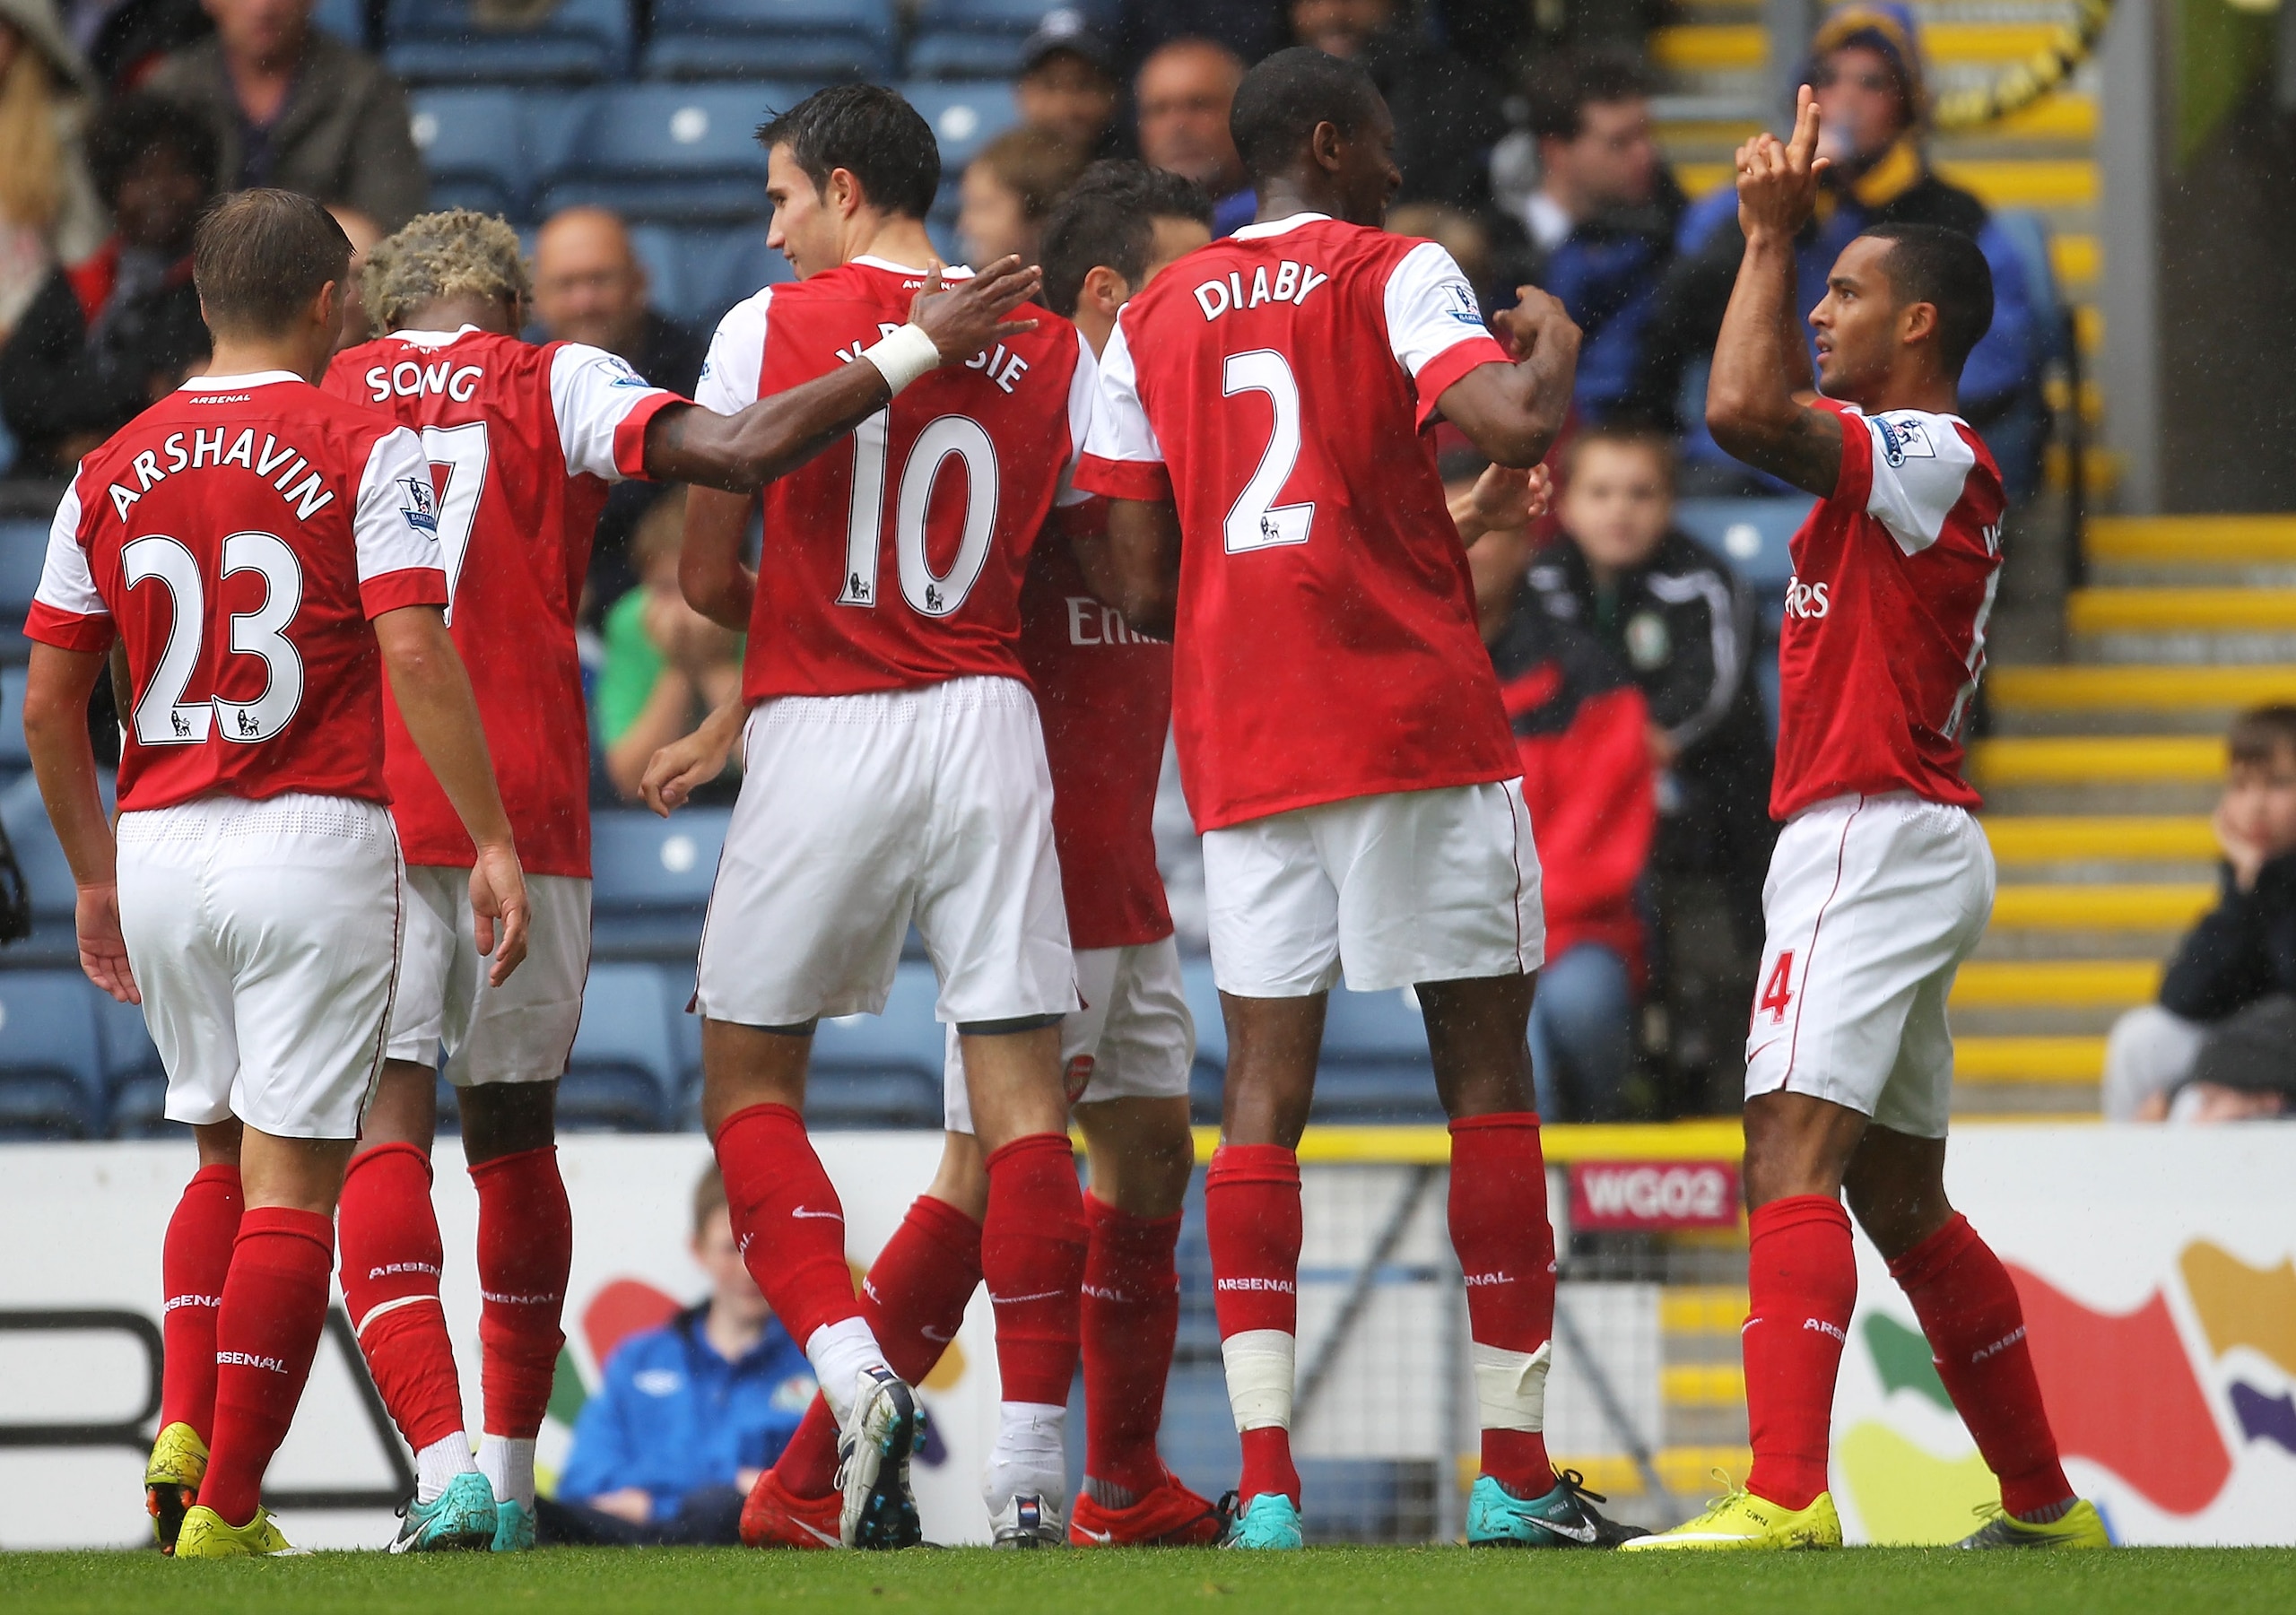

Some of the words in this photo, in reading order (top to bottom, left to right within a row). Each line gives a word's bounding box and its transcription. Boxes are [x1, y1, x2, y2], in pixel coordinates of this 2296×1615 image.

[1194, 260, 1327, 321] DIABY
[189, 395, 251, 404] ARSENAL
[365, 360, 483, 403] SONG
[108, 427, 334, 523] ARSHAVIN
[1222, 348, 1315, 554] 2
[422, 421, 489, 628] 7
[835, 404, 999, 618] 10
[121, 530, 304, 746] 23
[1218, 1278, 1295, 1295] ARSENAL
